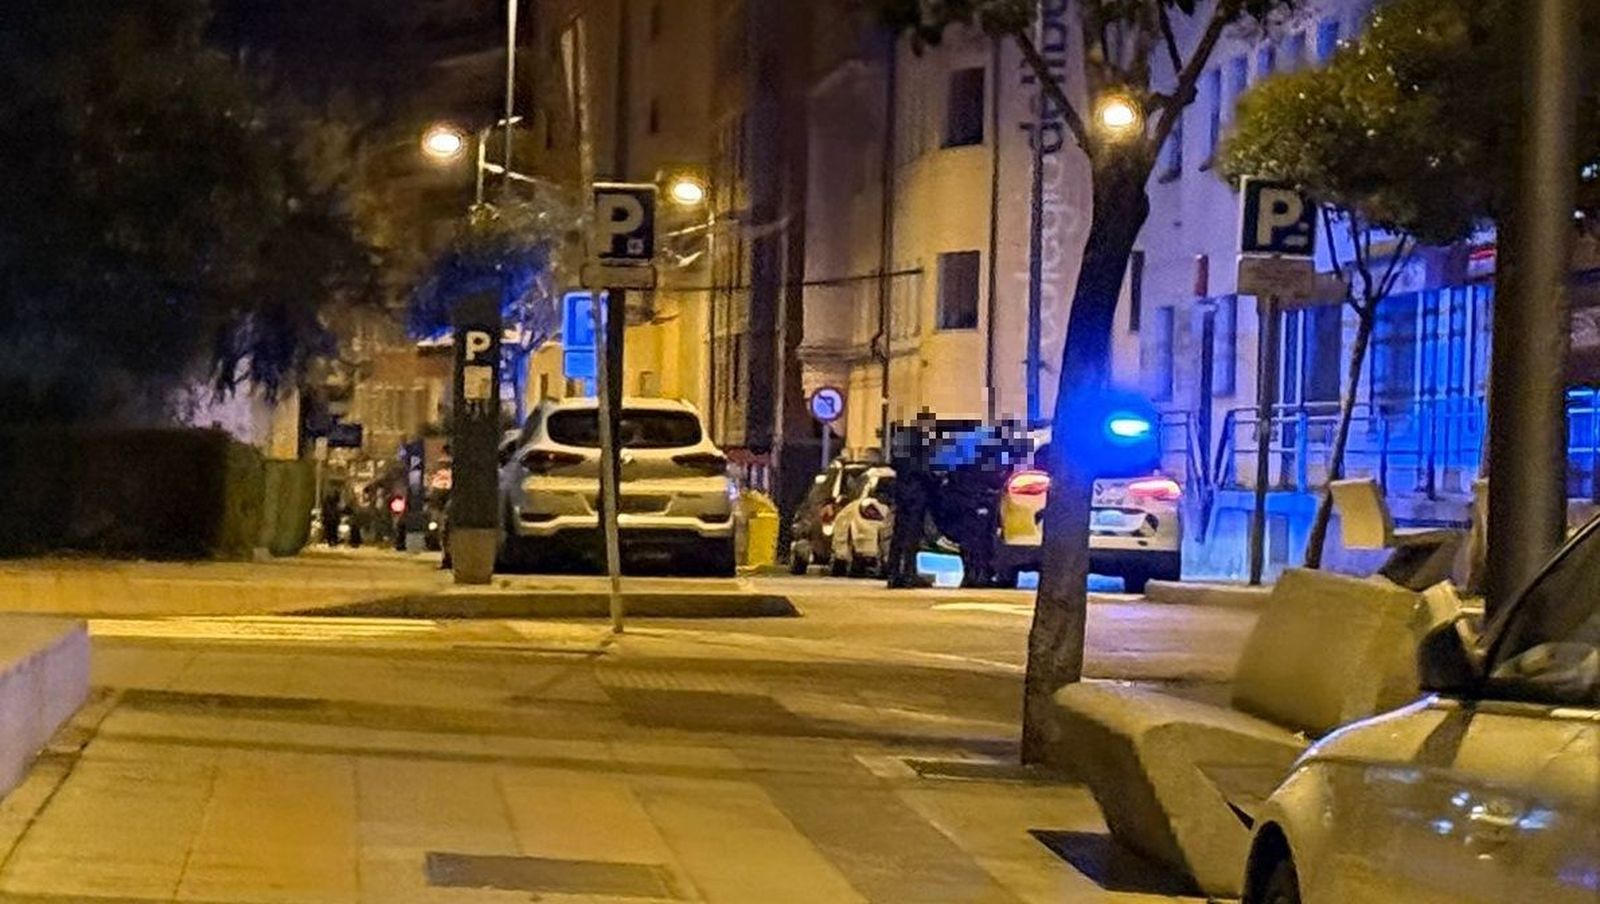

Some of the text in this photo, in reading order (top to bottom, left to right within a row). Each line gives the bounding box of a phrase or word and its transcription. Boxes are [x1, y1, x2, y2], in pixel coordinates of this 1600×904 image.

[598, 193, 644, 254] P
[1257, 188, 1305, 246] P
[465, 331, 492, 361] P
